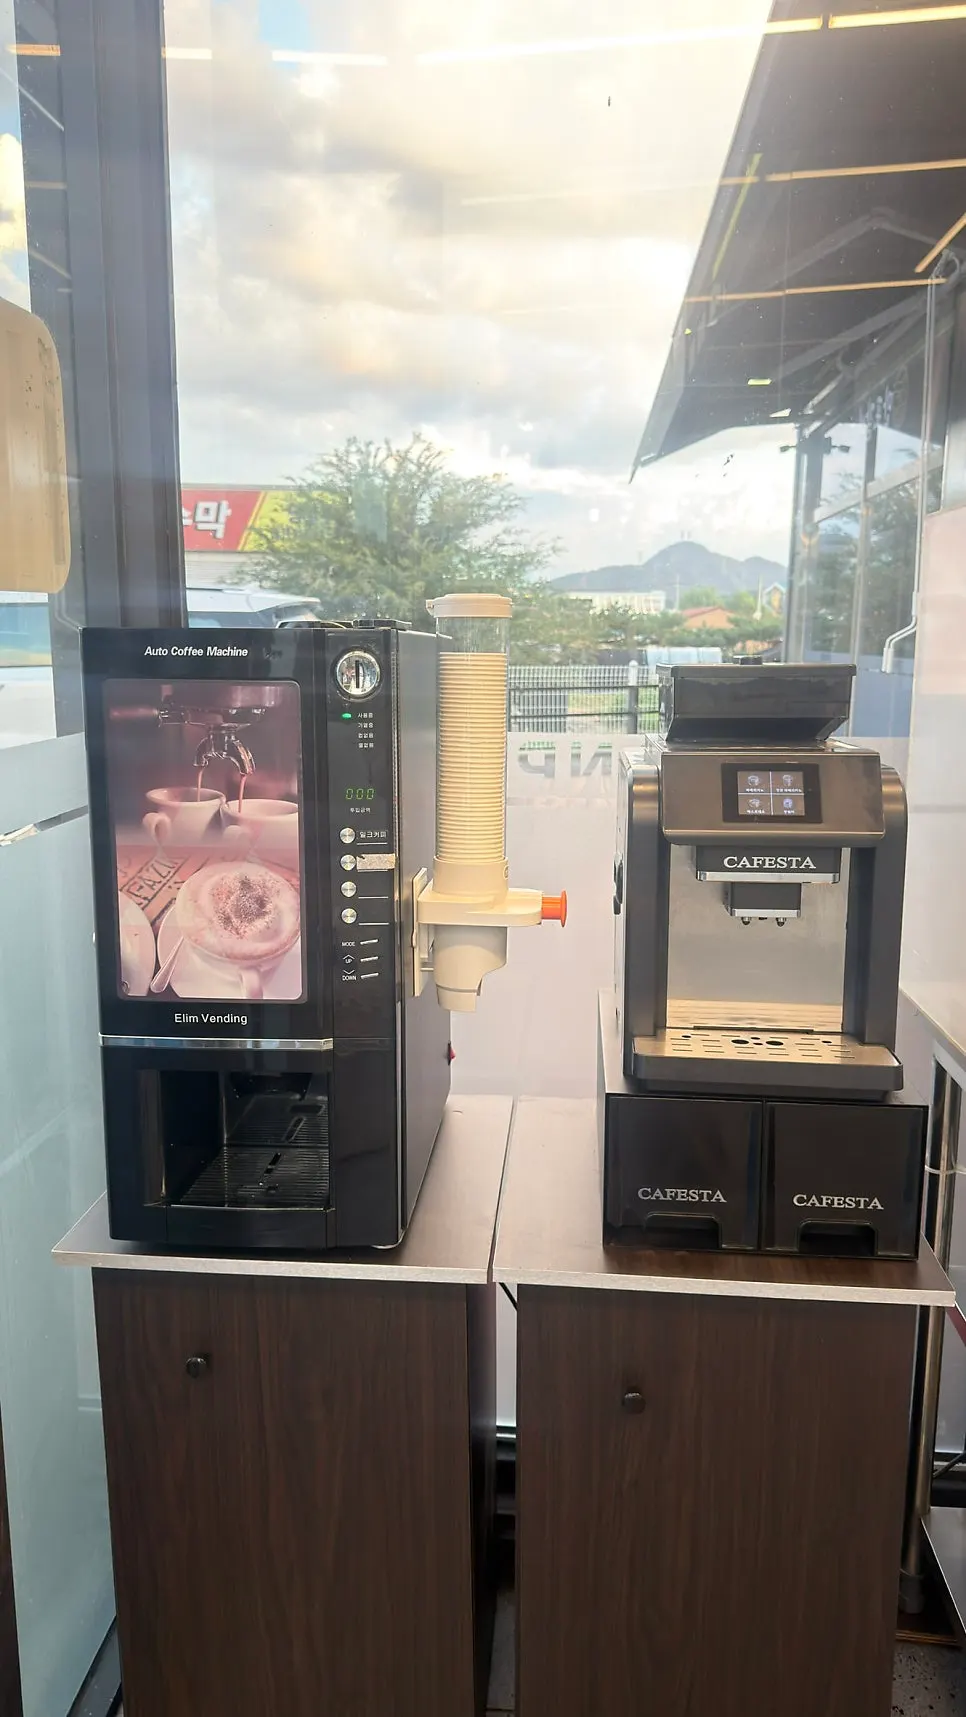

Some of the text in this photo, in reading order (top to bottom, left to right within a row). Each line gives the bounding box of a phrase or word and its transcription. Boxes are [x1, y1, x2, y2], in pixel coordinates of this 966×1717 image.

[144, 646, 249, 657] Auto Coffee Machine
[345, 788, 375, 800] 000
[359, 831, 387, 839] 밀크커피
[723, 856, 817, 869] CAFESTA
[174, 1013, 248, 1026] Elim Vending
[637, 1187, 727, 1203] CAFESTA
[793, 1194, 884, 1210] CAFESTA
